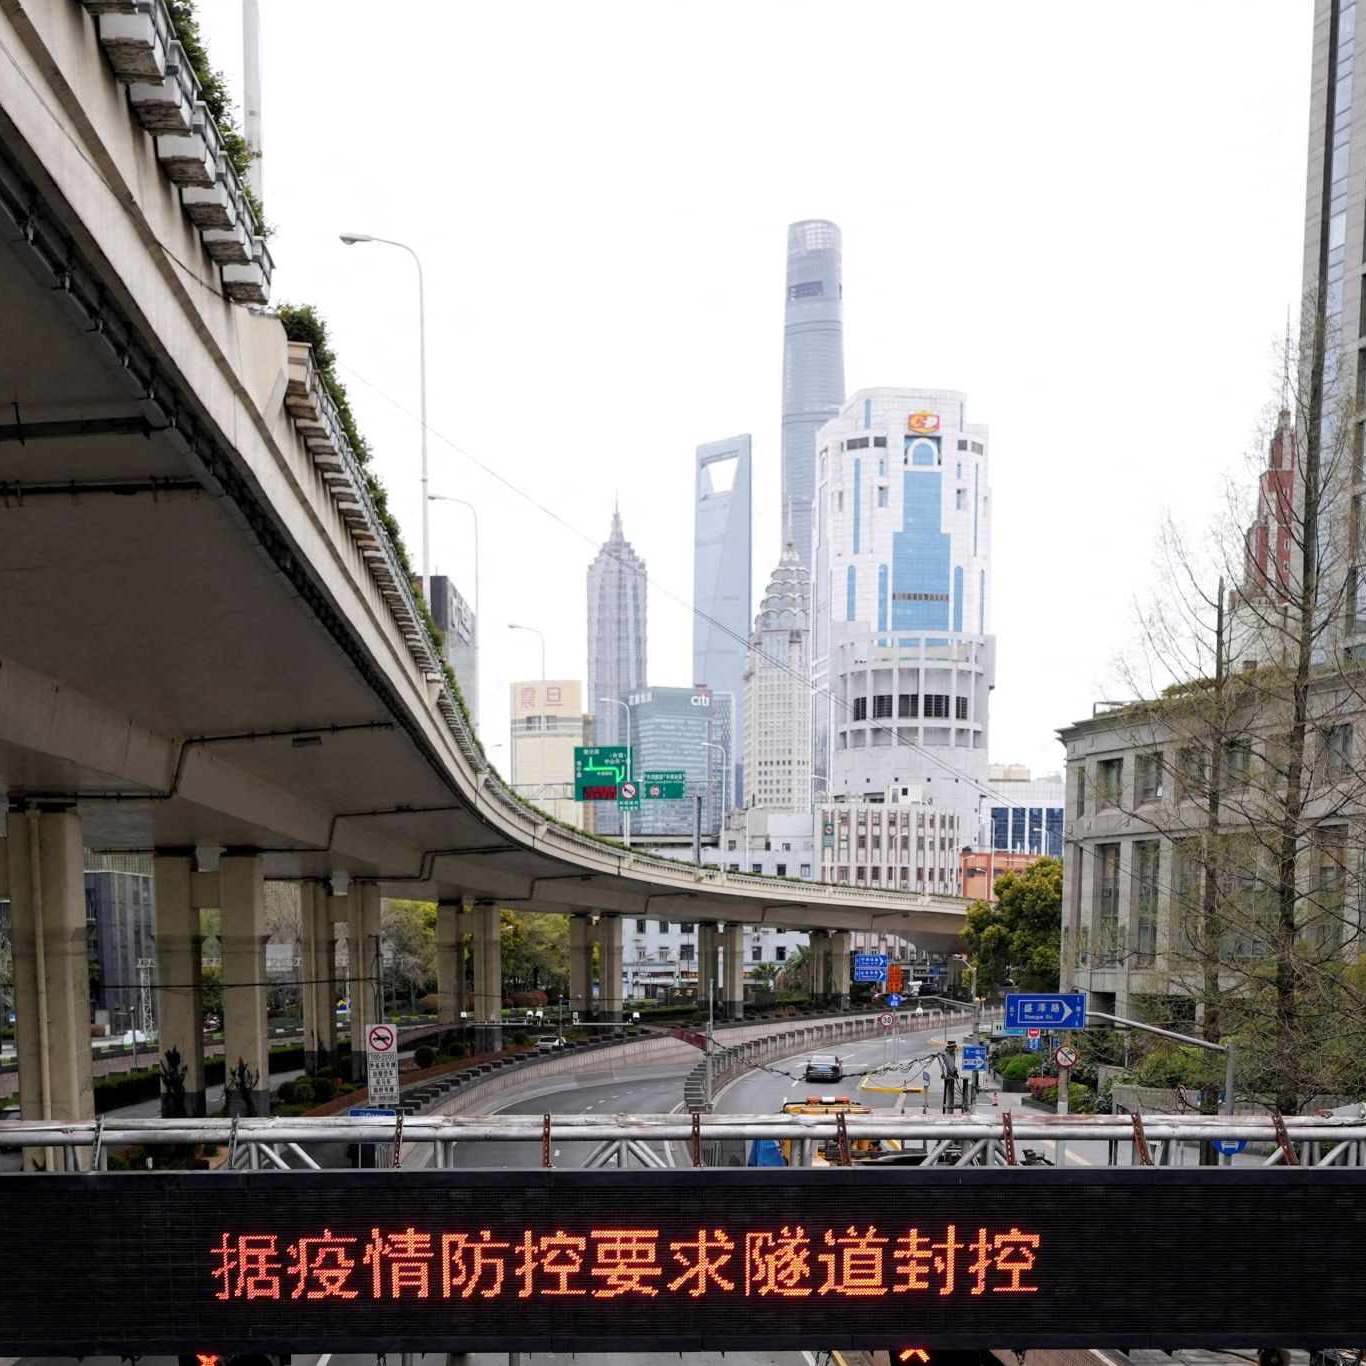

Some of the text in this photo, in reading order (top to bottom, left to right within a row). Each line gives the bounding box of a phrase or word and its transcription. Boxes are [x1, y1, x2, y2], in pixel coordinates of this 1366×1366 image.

[520, 687, 563, 708] 震旦
[690, 694, 710, 707] citi
[1023, 1003, 1060, 1013] 盛泽路
[883, 1016, 891, 1024] 30
[211, 1225, 1039, 1300] 据疫情防控要求隧道封控
